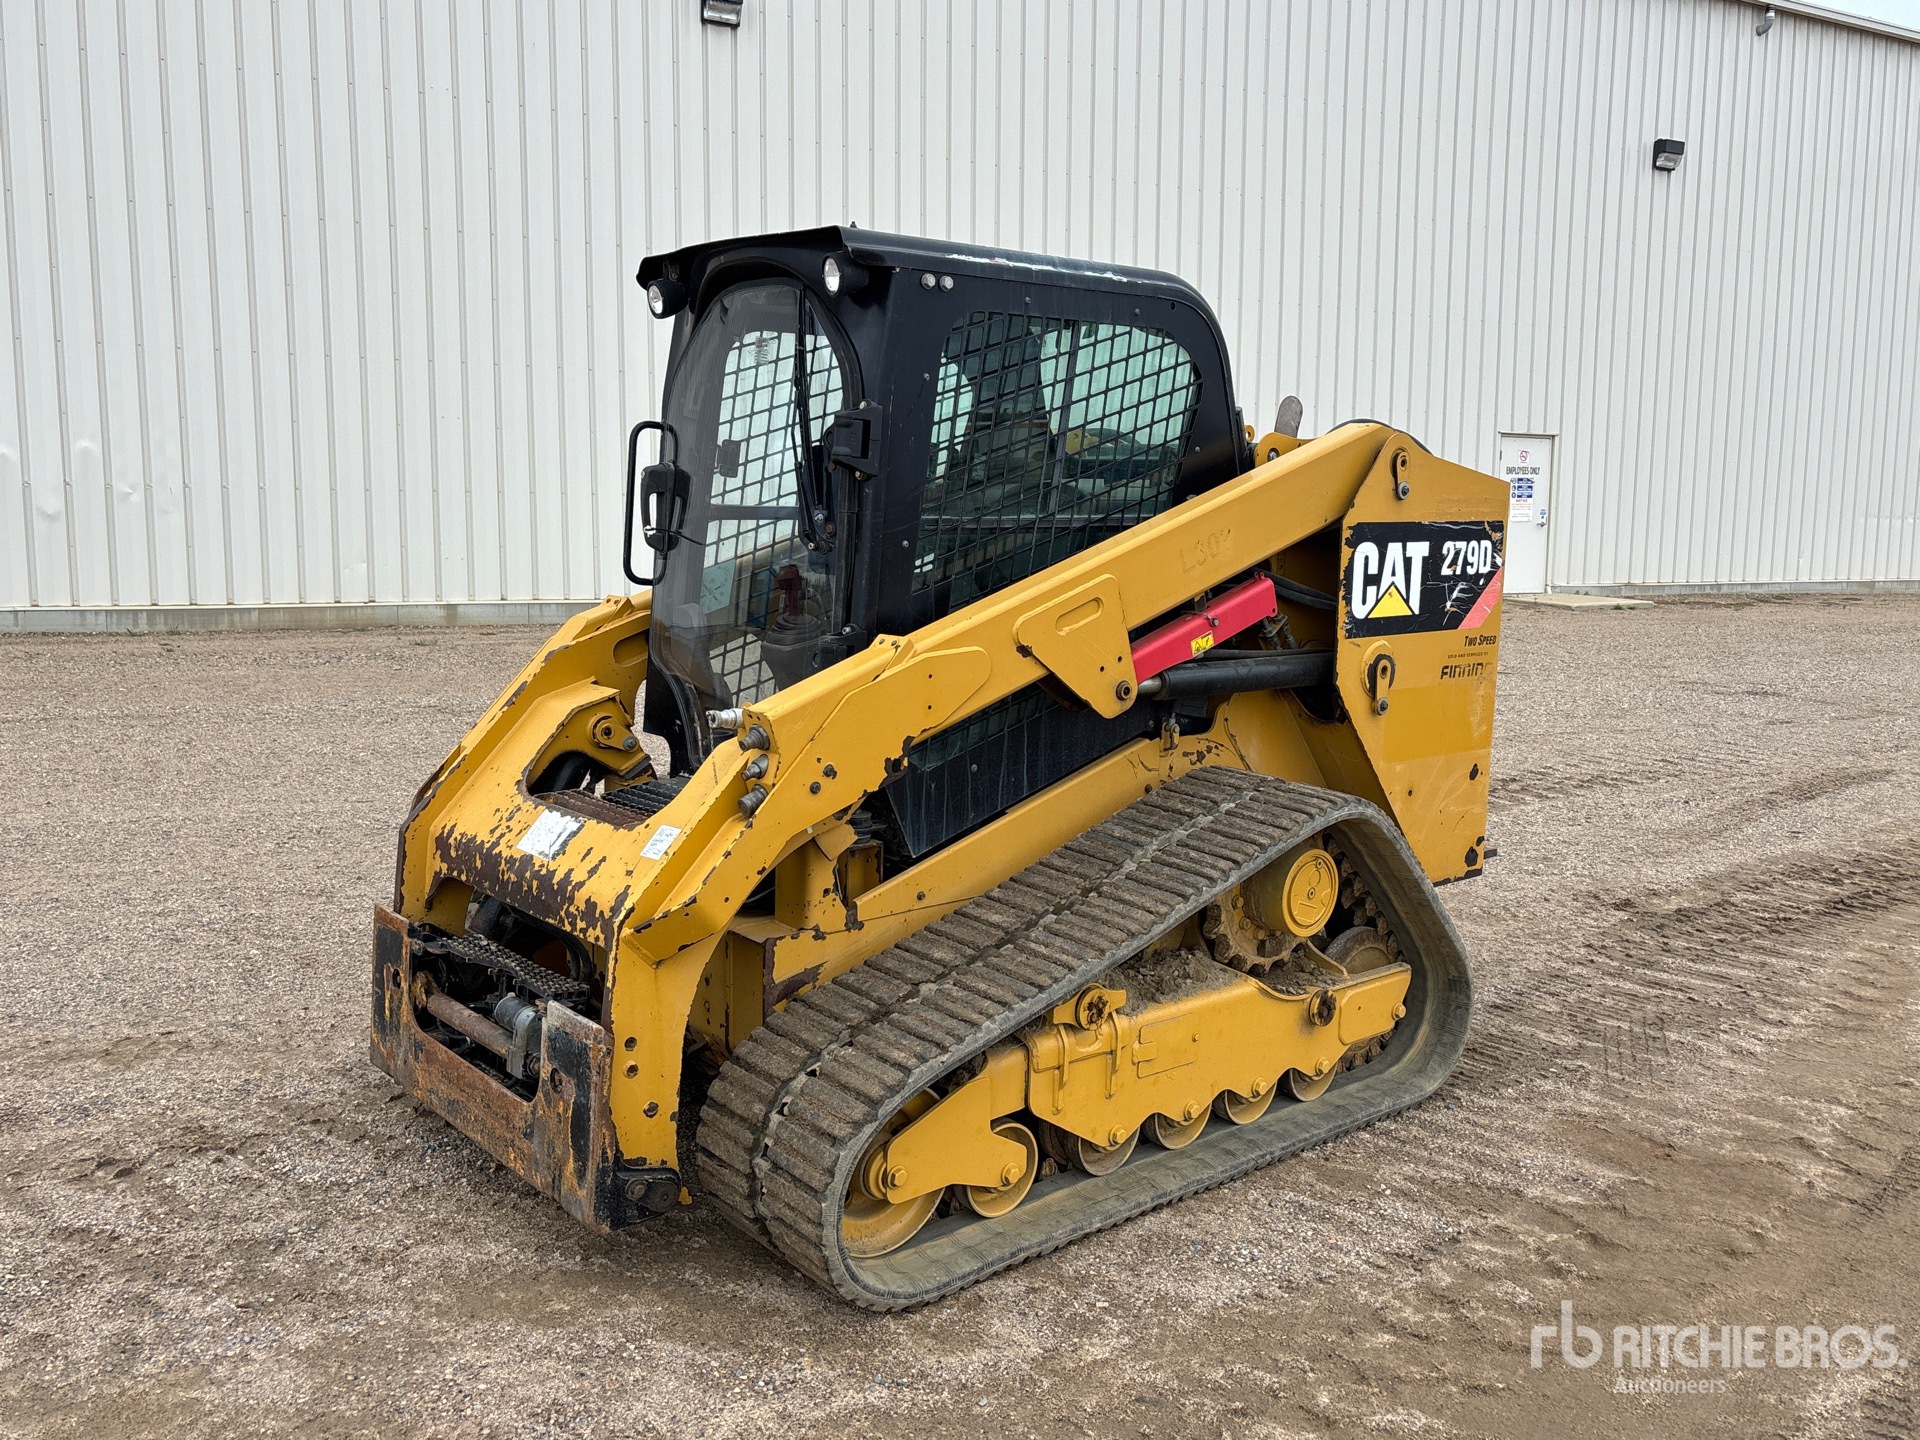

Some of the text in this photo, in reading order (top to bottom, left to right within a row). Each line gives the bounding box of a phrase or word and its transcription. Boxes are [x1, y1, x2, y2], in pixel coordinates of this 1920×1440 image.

[1506, 466, 1540, 475] EMPLOYEES ONLY
[1441, 540, 1493, 575] 279D
[1351, 541, 1430, 619] CAT
